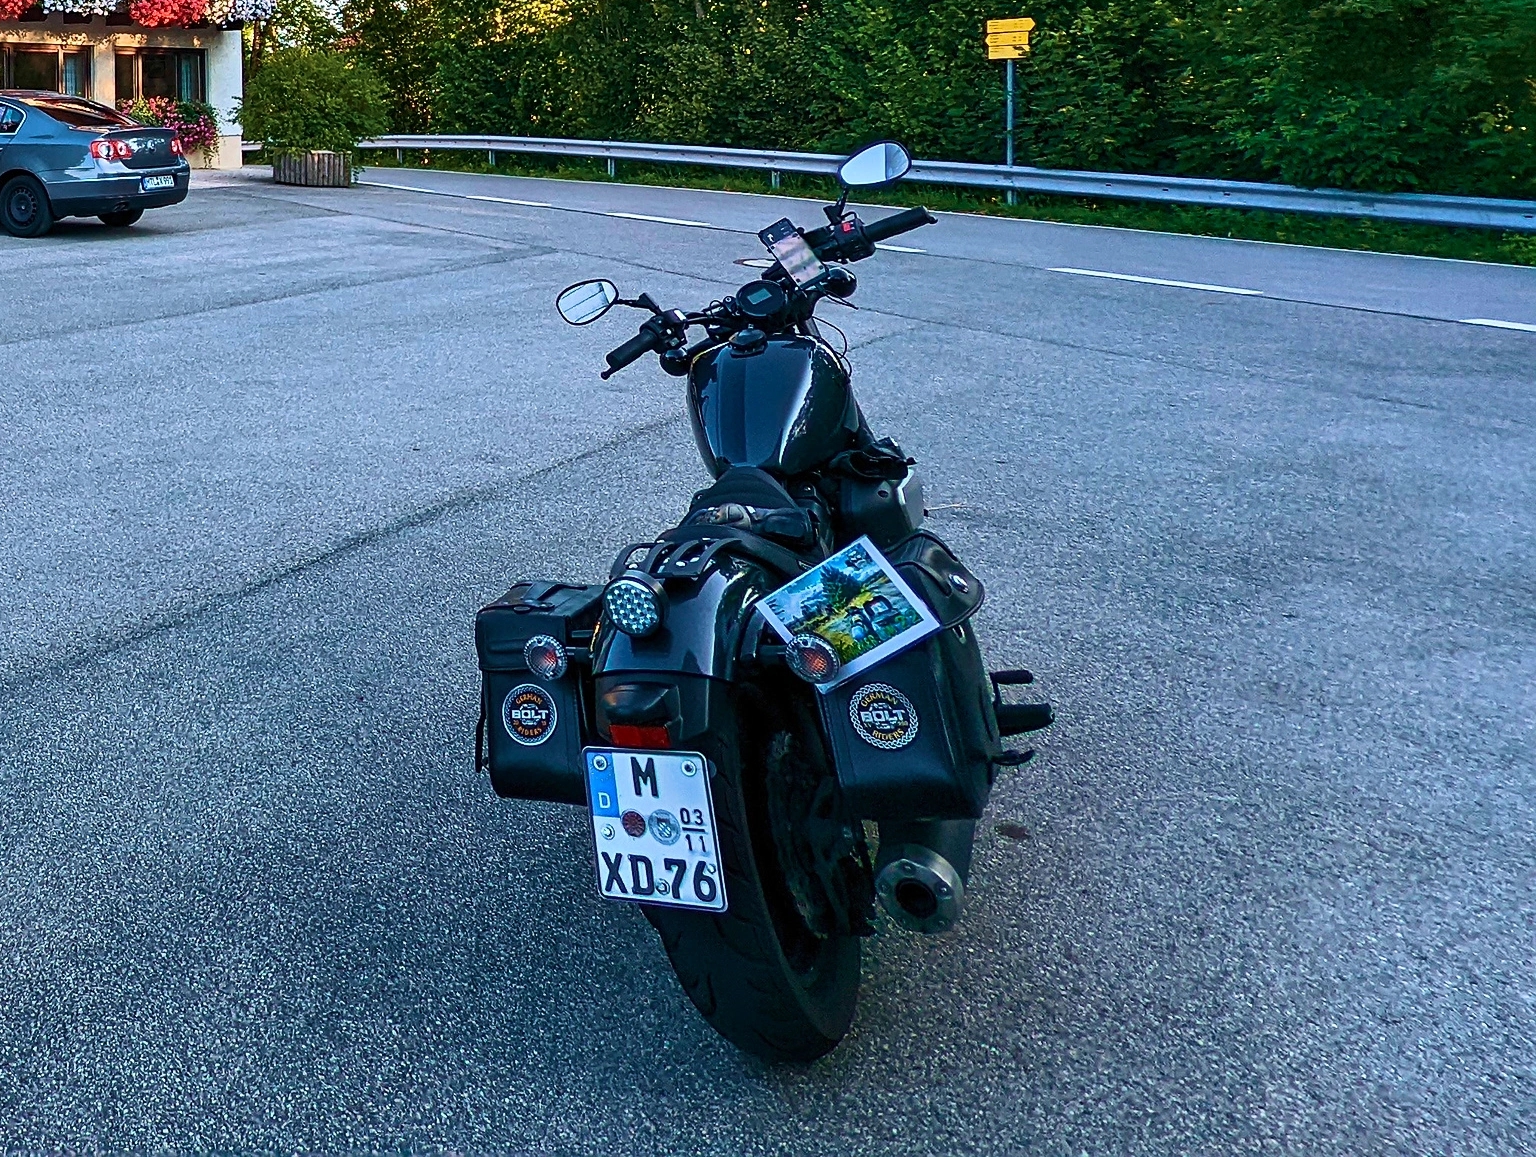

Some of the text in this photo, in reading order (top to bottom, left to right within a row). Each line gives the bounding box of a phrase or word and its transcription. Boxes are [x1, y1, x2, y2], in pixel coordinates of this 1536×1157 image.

[860, 691, 898, 707] GERMAN
[511, 709, 548, 720] BOLT
[860, 709, 905, 723] BOLT
[872, 728, 904, 741] RIDERS
[630, 756, 660, 799] M
[597, 792, 611, 809] D
[679, 807, 704, 826] 03
[684, 834, 707, 853] 11
